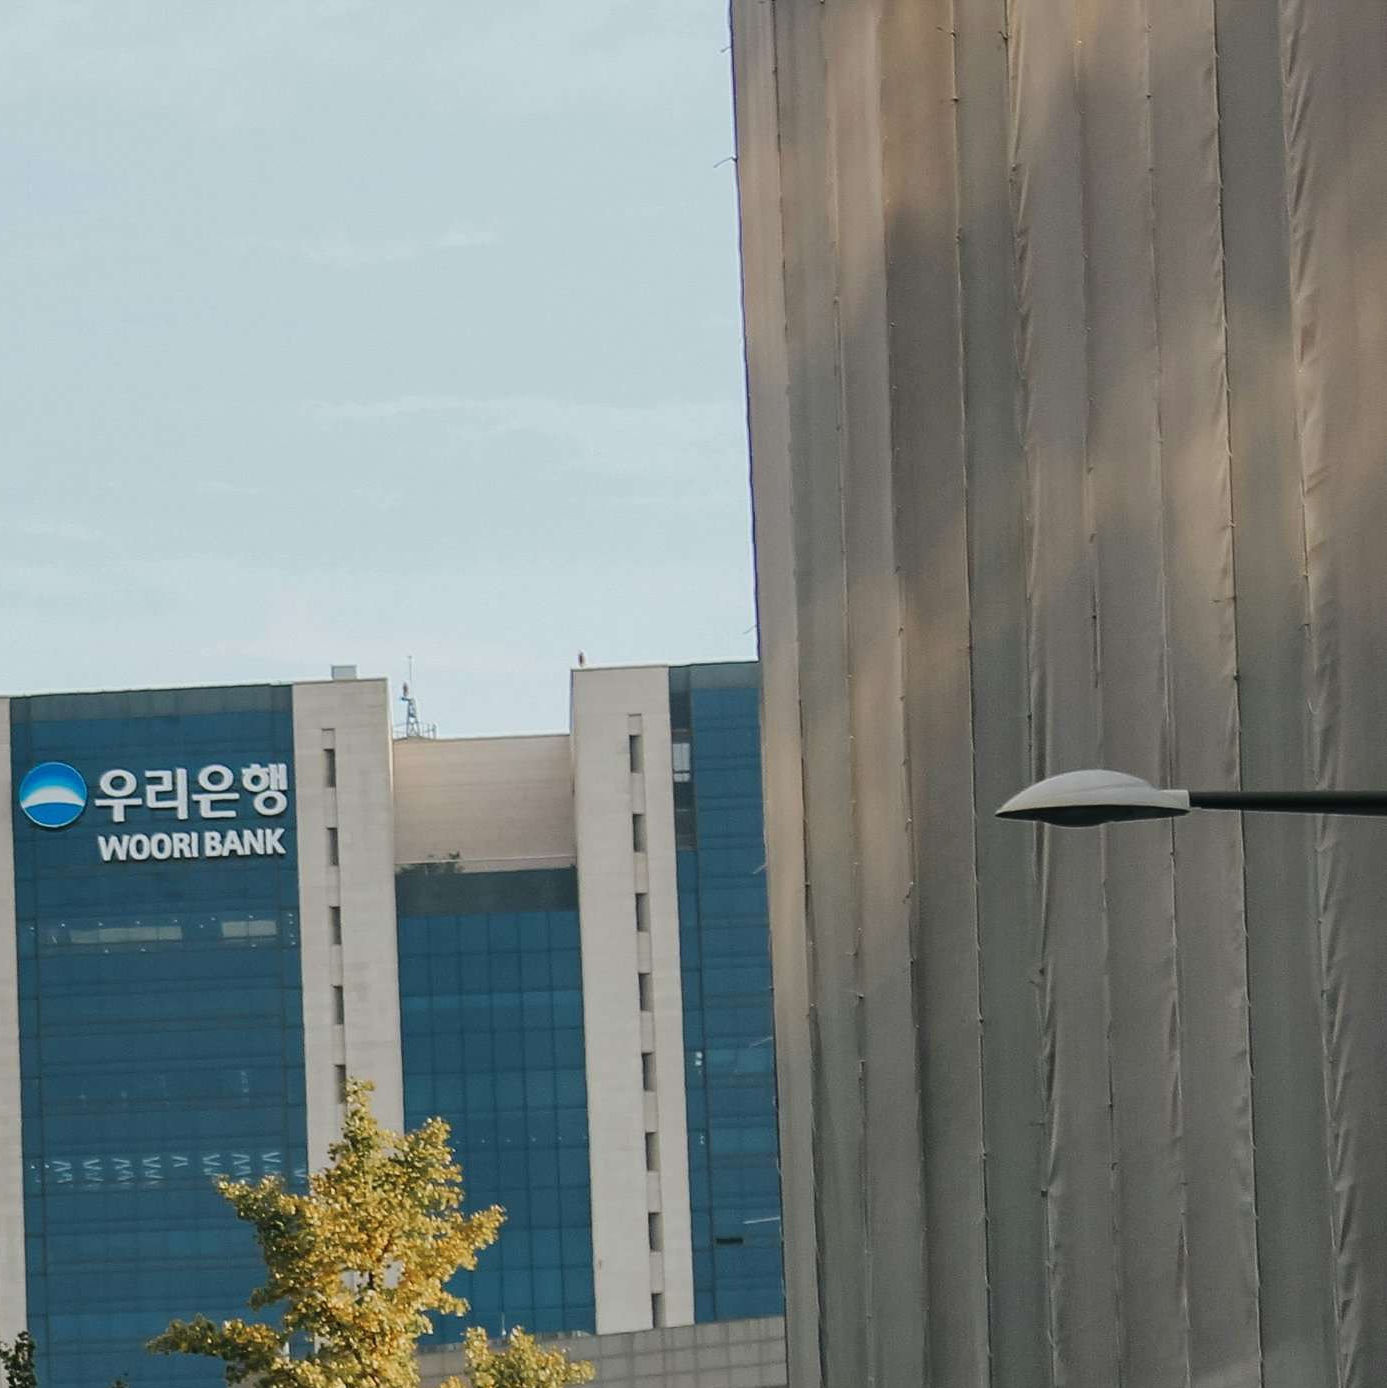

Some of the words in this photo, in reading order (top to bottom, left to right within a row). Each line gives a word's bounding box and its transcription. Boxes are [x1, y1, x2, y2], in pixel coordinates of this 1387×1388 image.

[94, 763, 288, 823] 우리은행
[97, 831, 199, 862] WOORI
[204, 827, 287, 858] BANK
